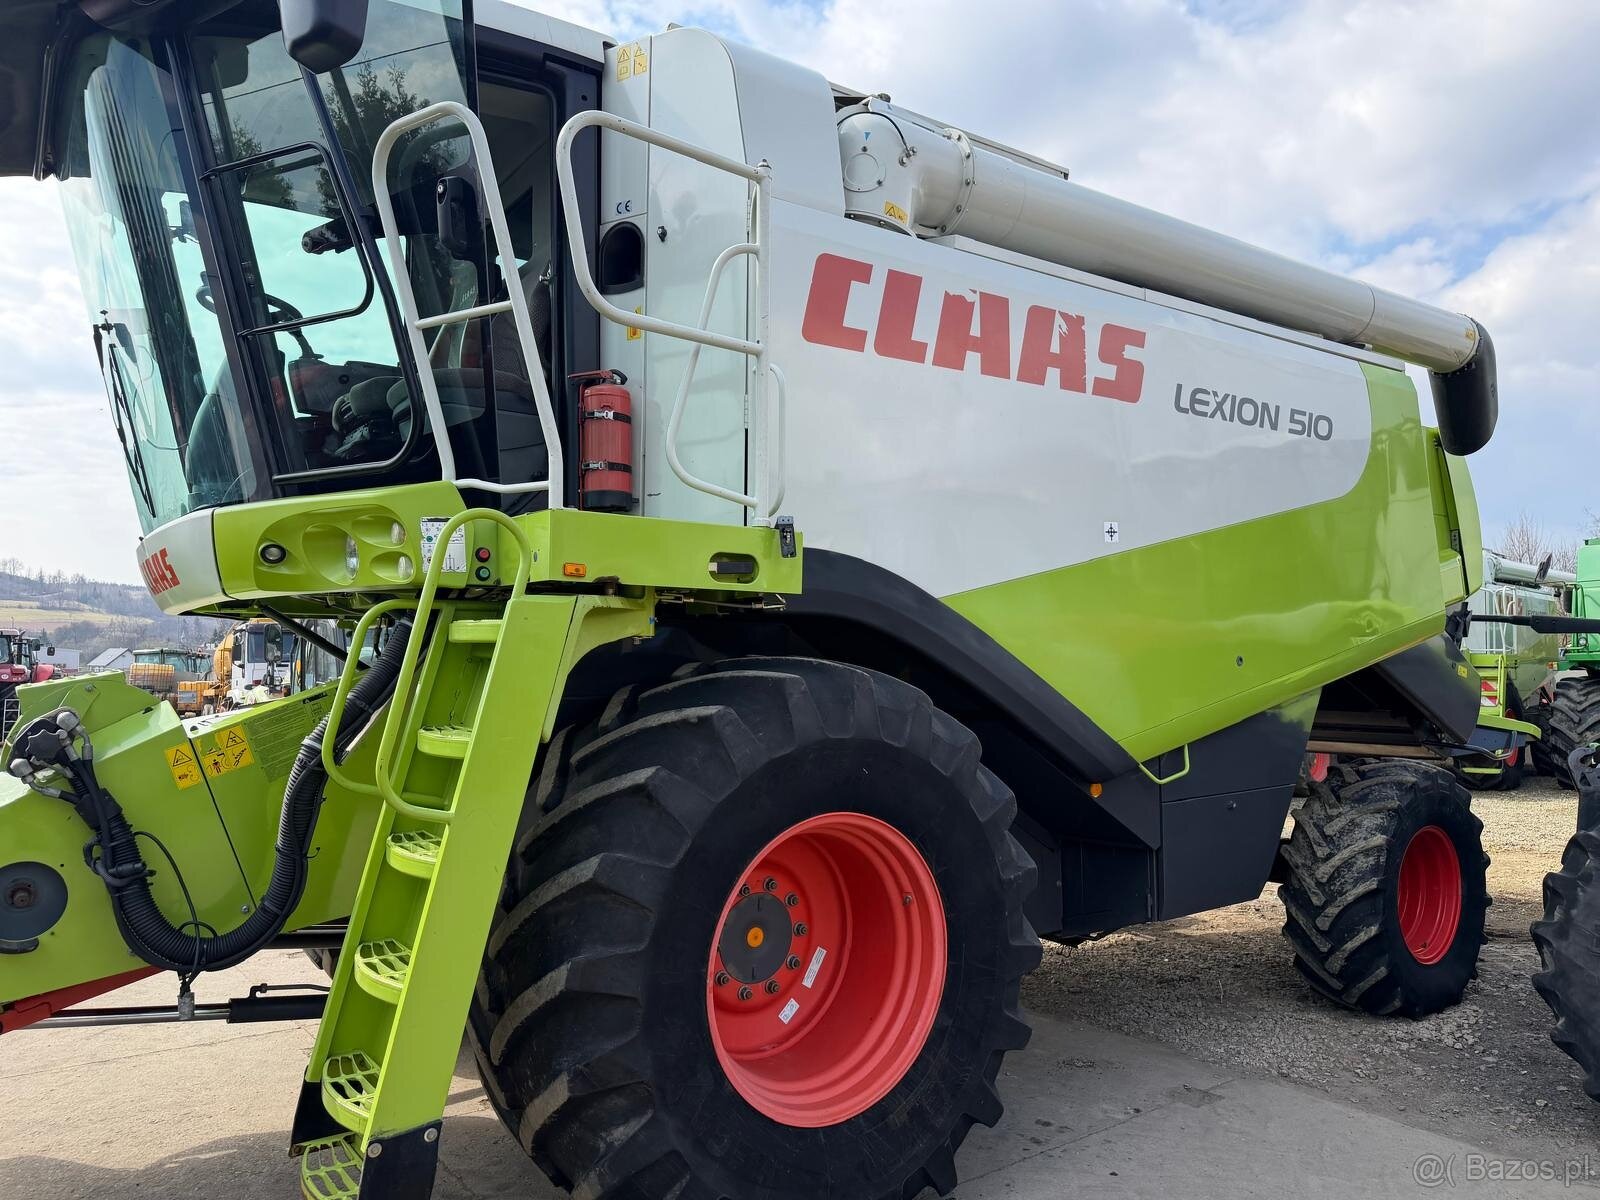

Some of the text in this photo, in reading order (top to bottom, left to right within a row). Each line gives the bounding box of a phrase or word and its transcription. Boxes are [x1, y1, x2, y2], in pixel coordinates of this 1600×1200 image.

[801, 252, 1147, 404] CLAAS
[1174, 383, 1334, 441] LEXION 510
